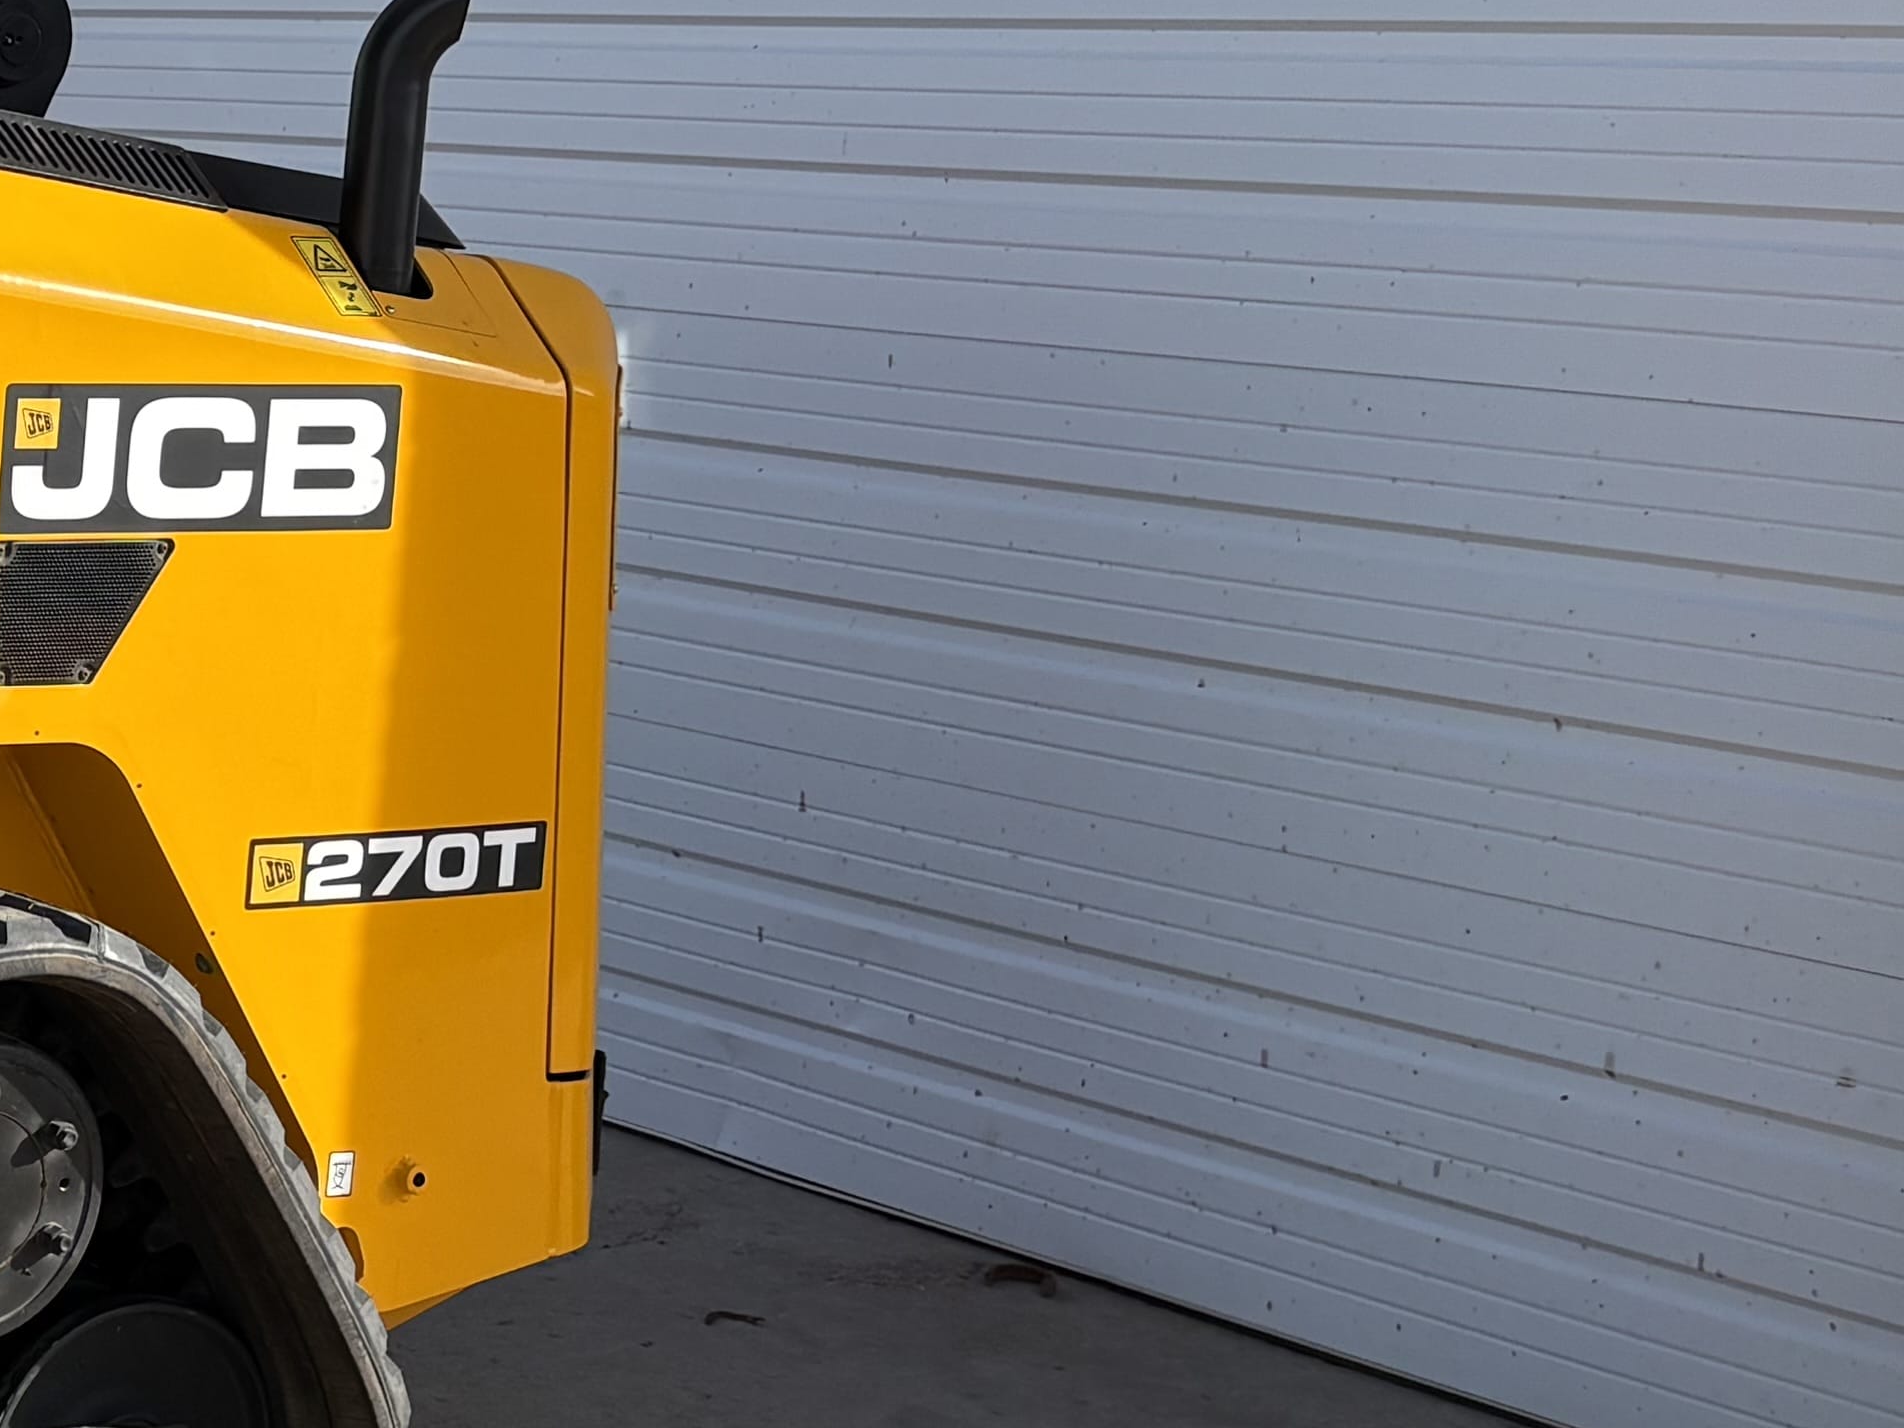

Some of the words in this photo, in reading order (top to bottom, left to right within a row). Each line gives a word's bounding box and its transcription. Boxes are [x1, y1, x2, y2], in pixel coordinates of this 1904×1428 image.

[27, 411, 52, 436] JCB
[11, 396, 387, 521] JCB
[265, 859, 295, 889] JCB
[303, 827, 537, 902] 270T
